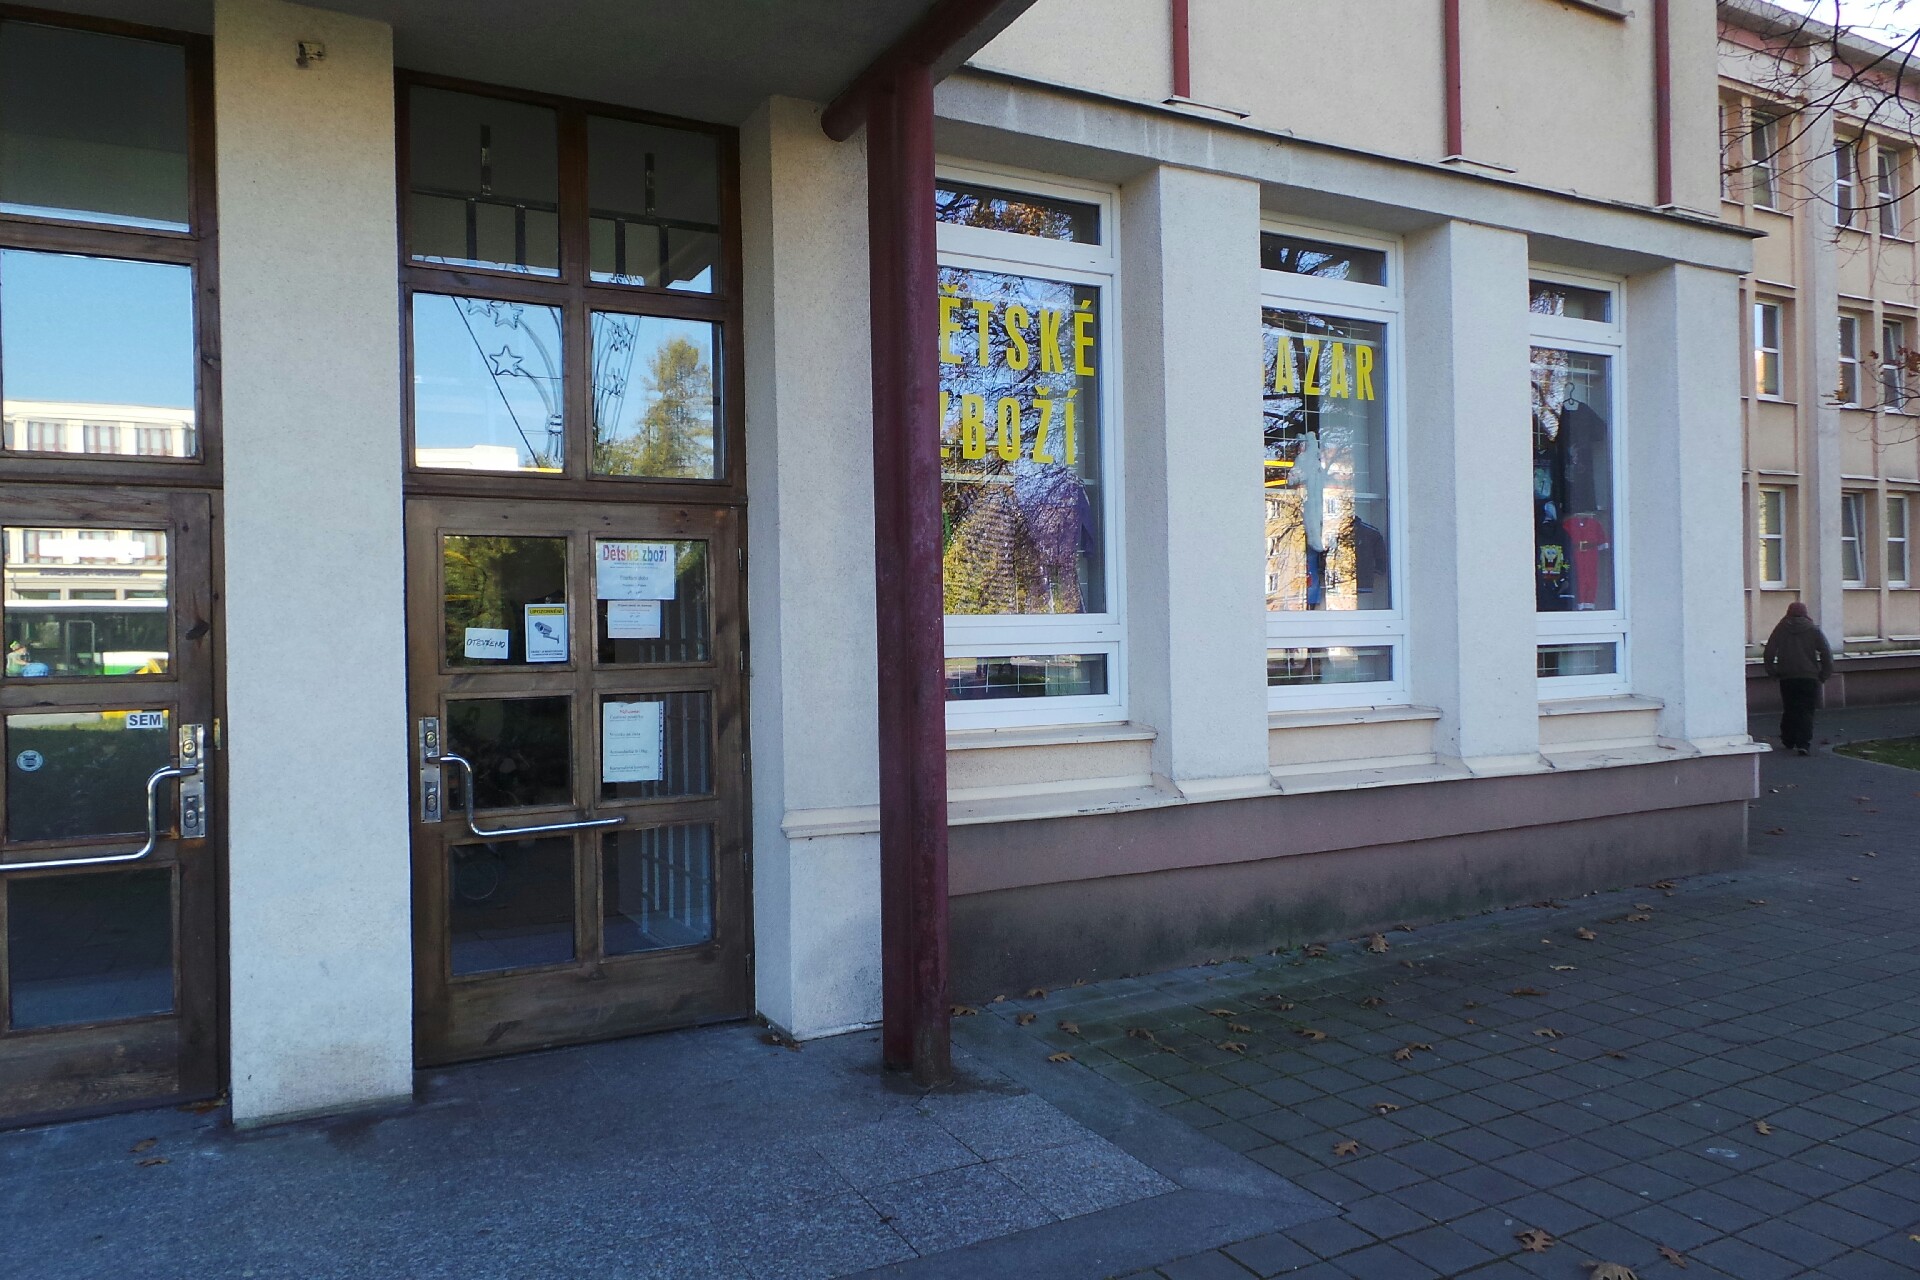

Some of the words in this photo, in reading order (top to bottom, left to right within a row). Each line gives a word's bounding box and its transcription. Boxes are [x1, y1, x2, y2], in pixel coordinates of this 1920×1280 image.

[939, 284, 1095, 377] ĚTSKÉ
[1262, 336, 1375, 401] AZAR
[602, 544, 640, 561] Dětské
[642, 545, 667, 563] zboží
[466, 637, 506, 649] OTEVŘENO
[129, 714, 161, 726] SEM
